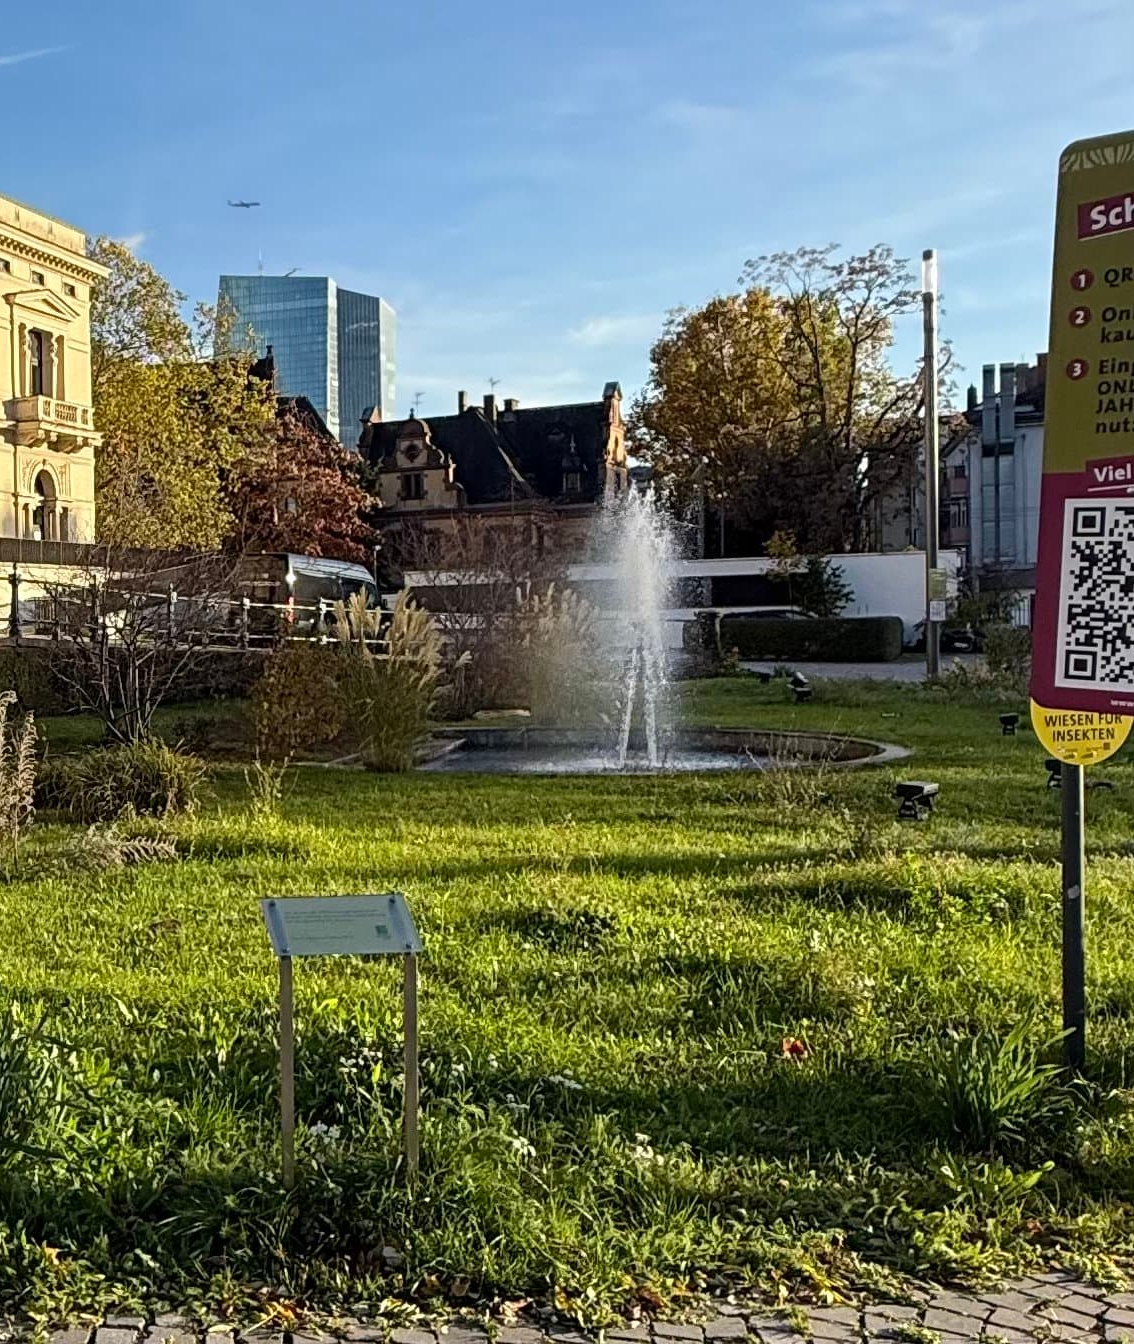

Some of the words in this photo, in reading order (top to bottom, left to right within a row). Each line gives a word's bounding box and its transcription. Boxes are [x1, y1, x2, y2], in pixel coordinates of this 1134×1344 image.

[1103, 267, 1134, 288] QR
[1075, 310, 1085, 324] 2
[1072, 362, 1082, 377] 3
[1095, 397, 1134, 414] JAH
[1093, 463, 1132, 482] Viel
[1044, 714, 1094, 728] WIESEN
[1052, 728, 1116, 743] INSEKTEN
